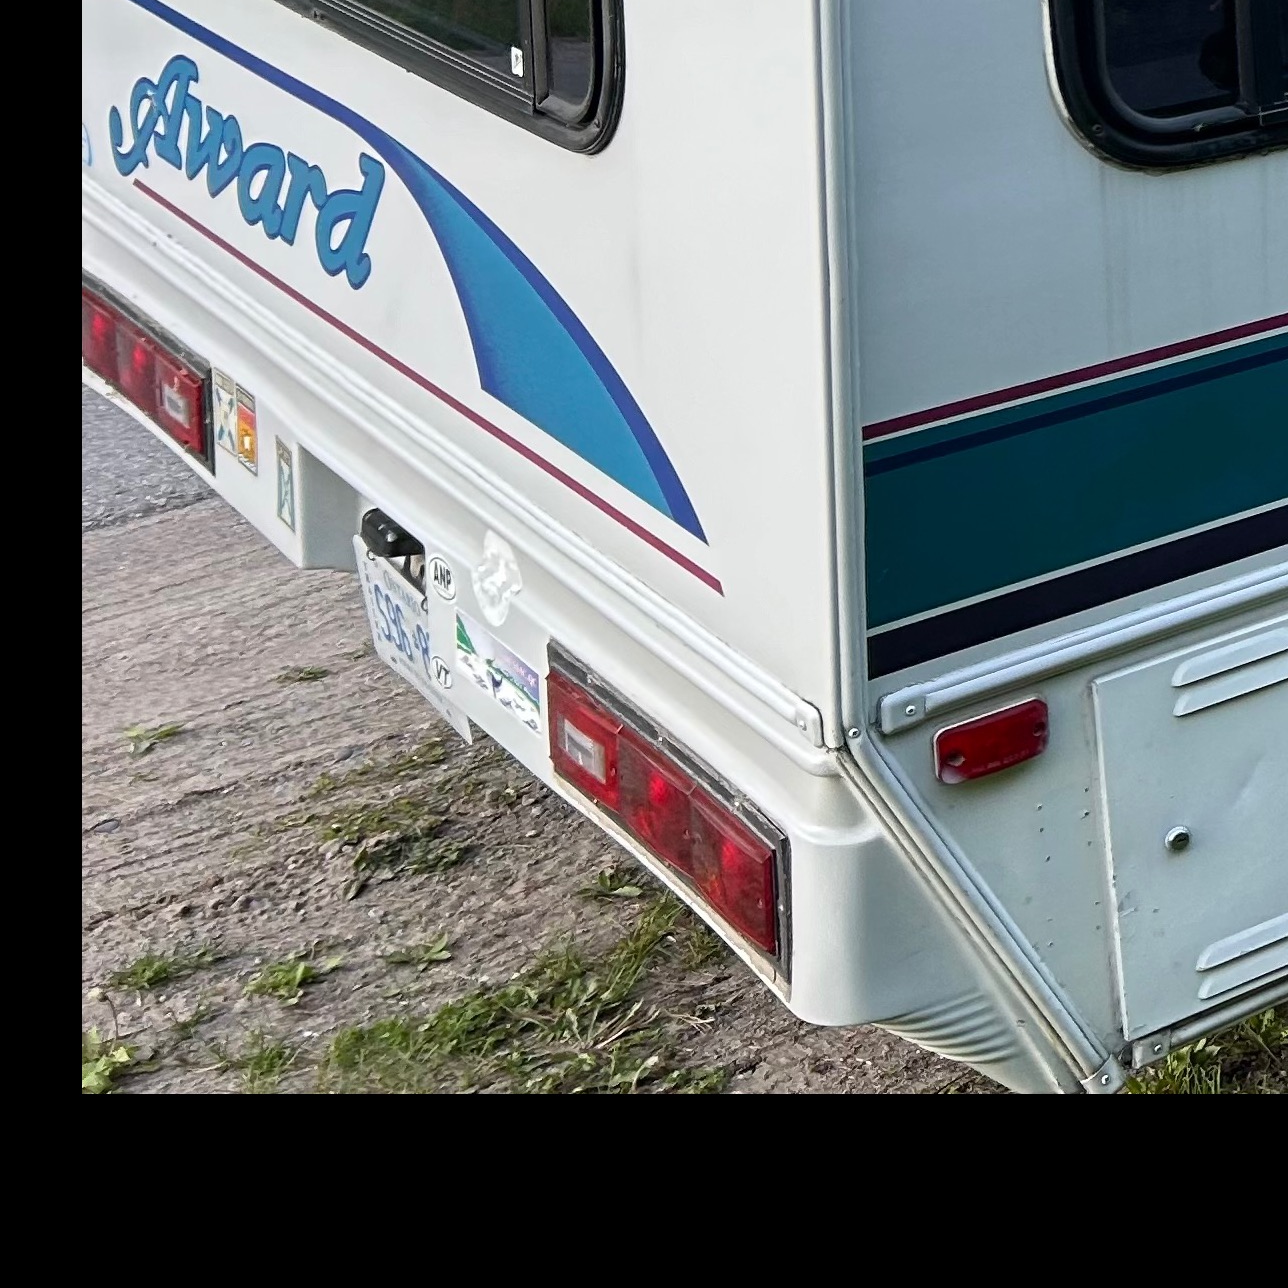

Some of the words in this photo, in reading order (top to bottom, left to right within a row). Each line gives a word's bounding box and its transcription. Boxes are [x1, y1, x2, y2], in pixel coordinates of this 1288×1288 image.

[109, 54, 386, 290] Award
[433, 560, 452, 591] ANP
[435, 660, 450, 686] VT
